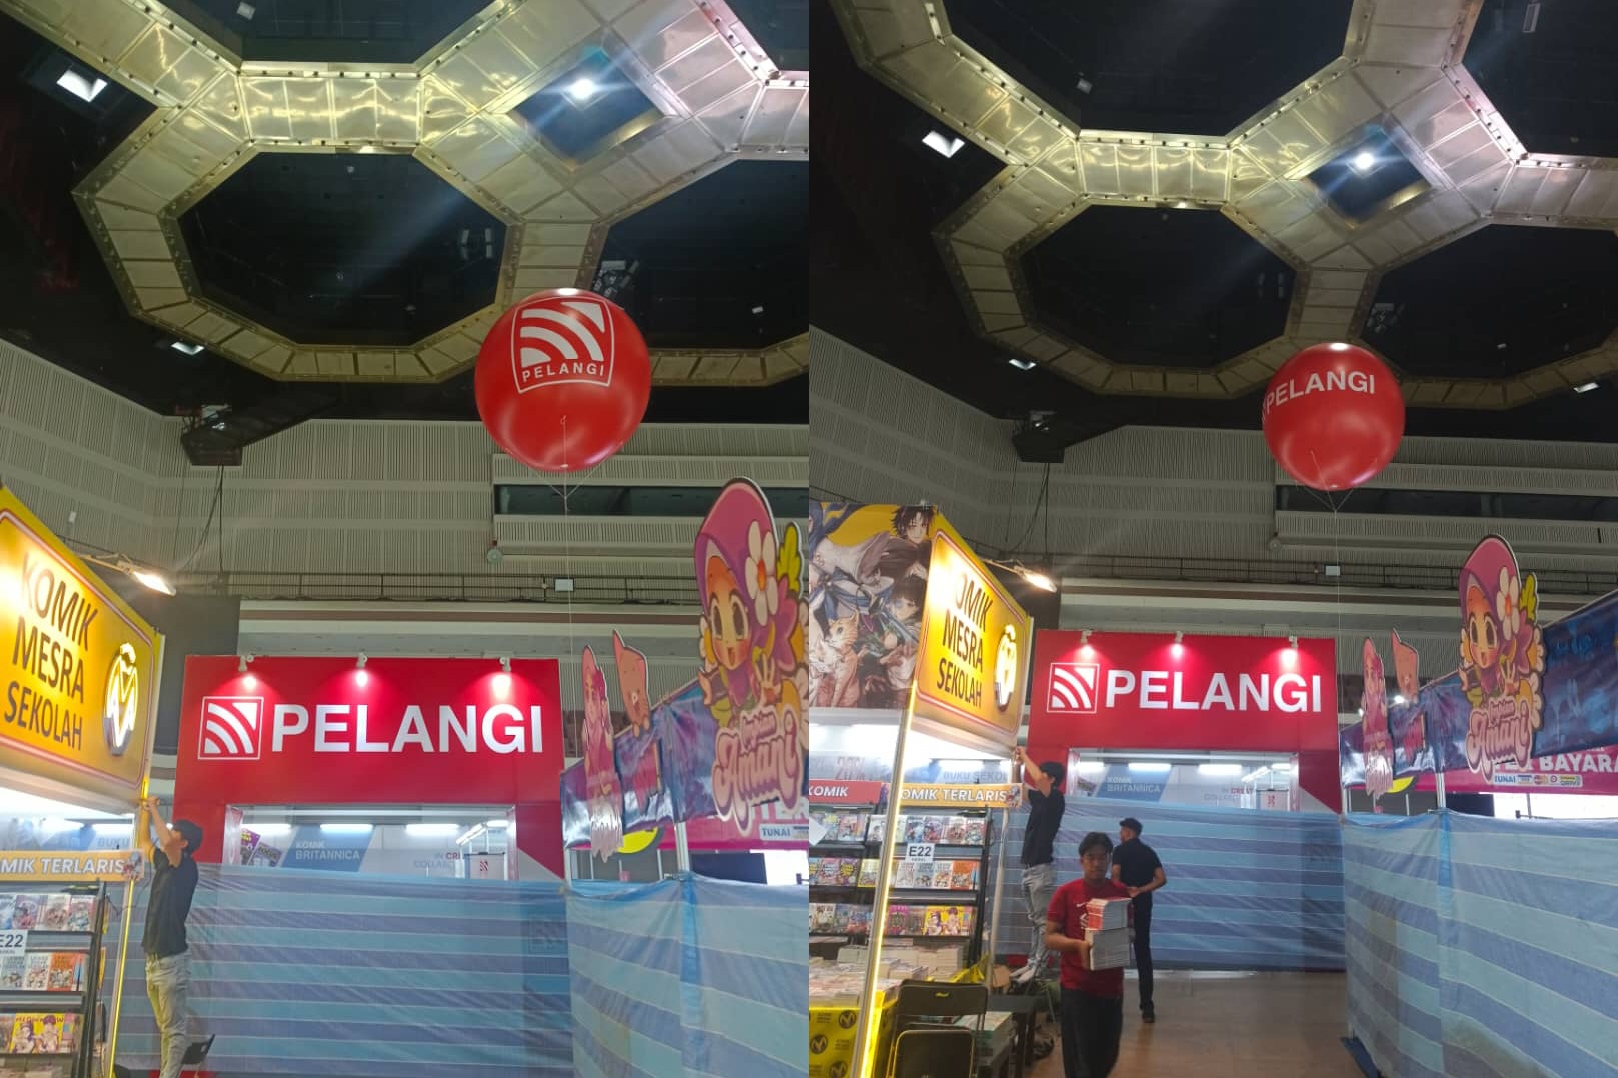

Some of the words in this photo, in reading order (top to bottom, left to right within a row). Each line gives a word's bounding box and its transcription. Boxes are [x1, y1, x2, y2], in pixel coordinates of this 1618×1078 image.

[522, 362, 605, 382] PELANGI
[1265, 370, 1375, 415] PELANGI
[21, 552, 98, 651] KOMIK
[954, 572, 994, 632] OMIK
[12, 616, 85, 703] MESRA
[942, 610, 984, 673] MESRA
[936, 657, 983, 709] SEKOLAH
[1105, 669, 1322, 713] PELANGI
[4, 680, 83, 750] SEKOLAH
[271, 703, 544, 754] PELANGI
[902, 789, 938, 800] OMIK
[943, 789, 1007, 801] TERLARIS
[295, 850, 360, 861] BRITANNICA
[761, 828, 791, 838] TUNAI
[909, 846, 932, 857] E22
[0, 858, 35, 873] MIK
[41, 859, 125, 874] TERLARIS
